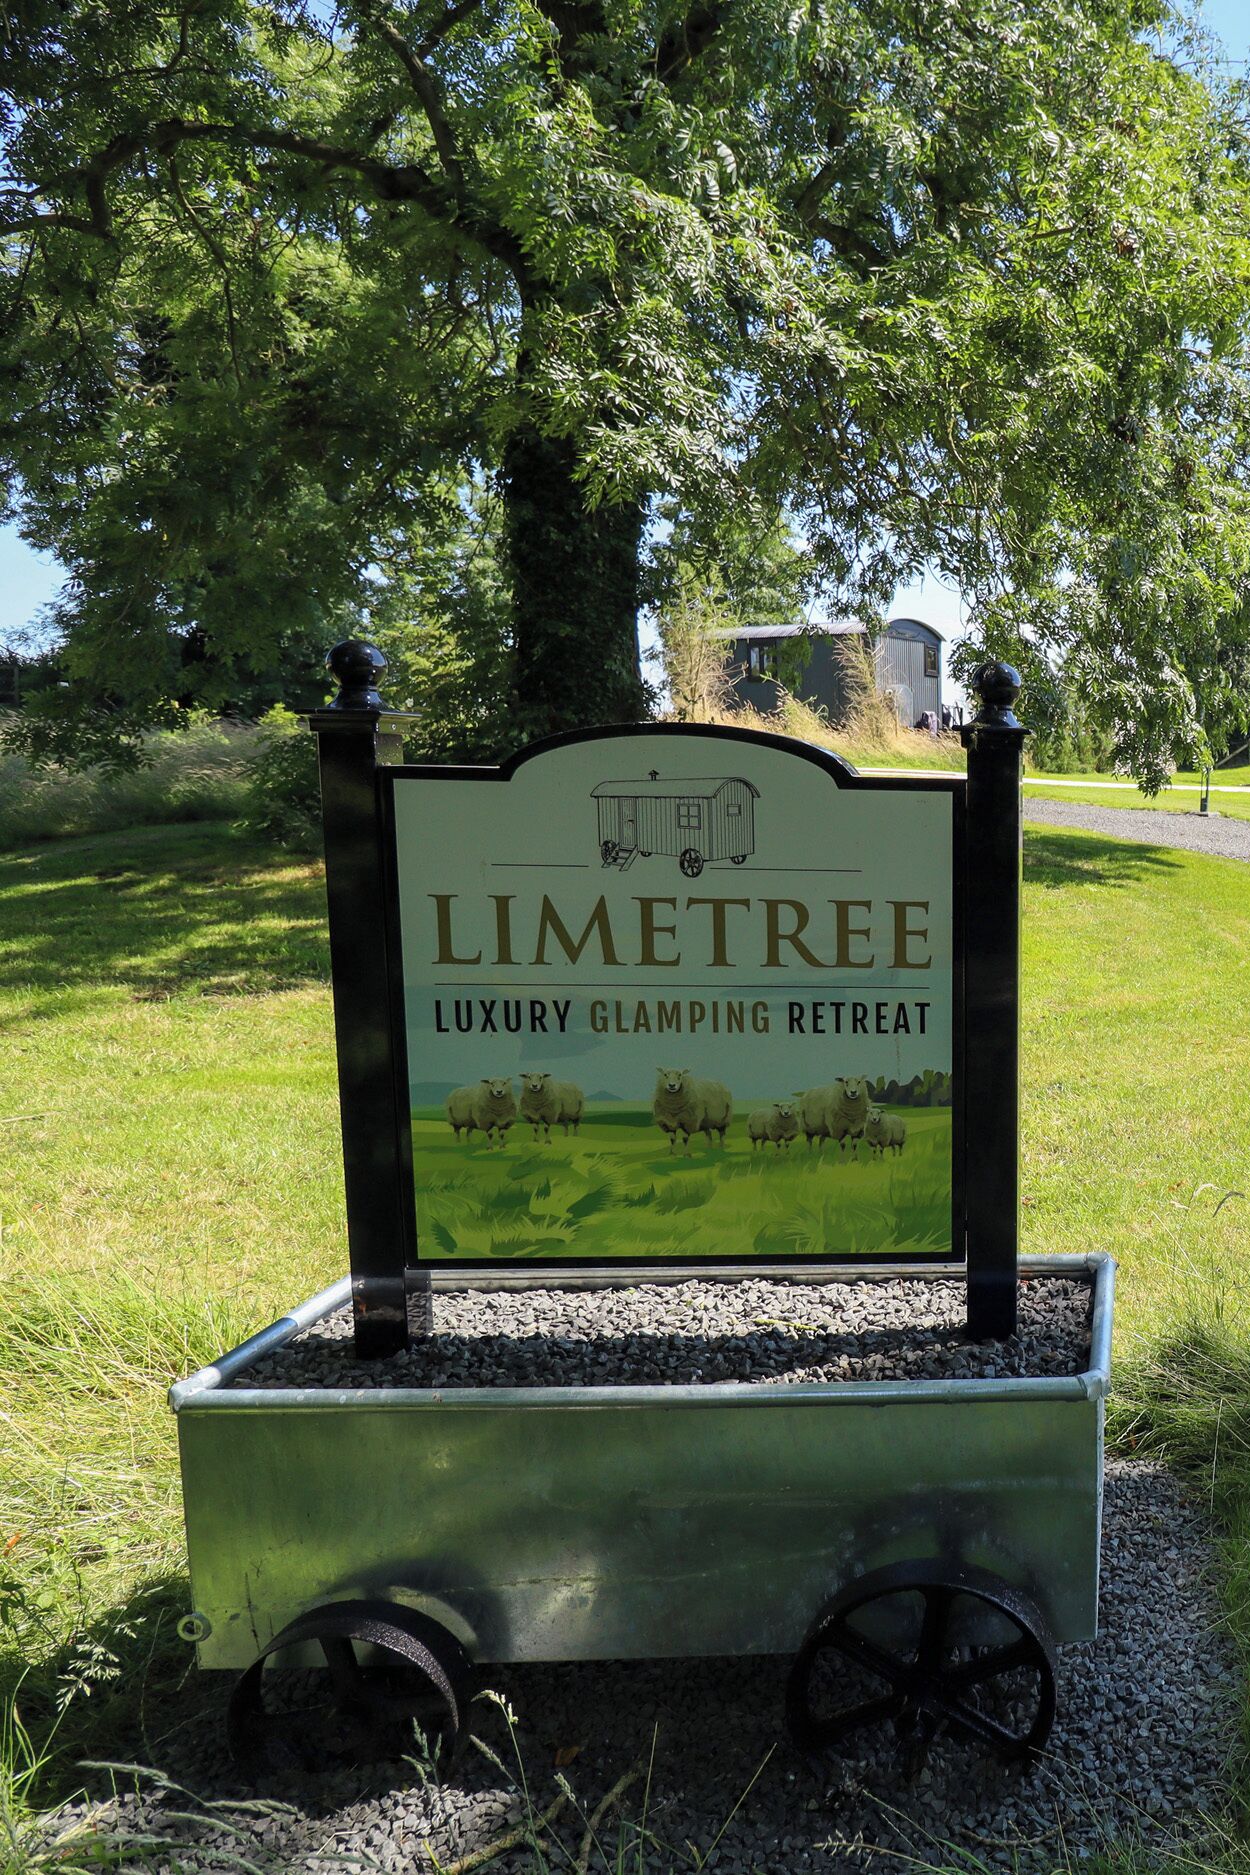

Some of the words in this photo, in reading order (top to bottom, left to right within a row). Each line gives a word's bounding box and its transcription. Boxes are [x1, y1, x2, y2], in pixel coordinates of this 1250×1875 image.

[427, 894, 932, 969] LIMETREE
[435, 1000, 570, 1034] LUXURY
[590, 1000, 770, 1034] GLAMPING
[788, 1002, 930, 1034] RETREAT
